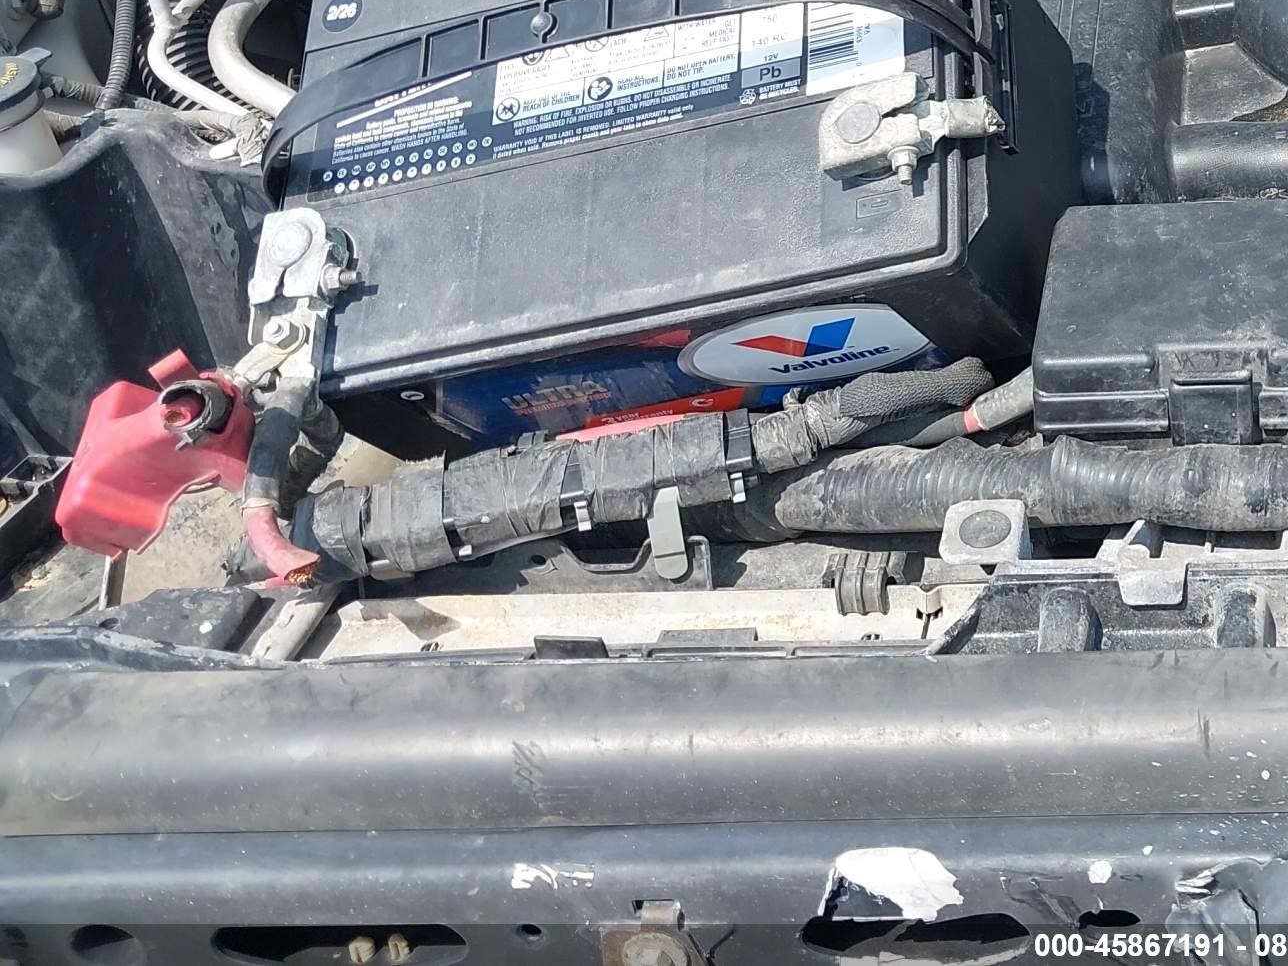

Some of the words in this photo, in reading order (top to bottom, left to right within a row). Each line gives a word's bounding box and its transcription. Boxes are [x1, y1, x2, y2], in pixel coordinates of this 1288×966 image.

[327, 2, 357, 21] 2/26
[763, 52, 778, 62] 12V
[759, 64, 781, 81] Pb
[522, 103, 540, 111] REACH
[551, 95, 579, 104] CHILDREN
[575, 103, 603, 113] EXPLOSION
[654, 84, 690, 95] DISASSEMBLE
[525, 119, 564, 132] RECOMMENDED
[577, 111, 602, 120] INVERTED
[616, 104, 637, 112] FOLLOW
[639, 98, 660, 107] PROPER
[661, 92, 688, 102] CHARGING
[493, 141, 523, 151] WARRANTY
[582, 122, 610, 132] REMOVED.
[612, 117, 634, 125] LIMITED
[635, 110, 666, 120] WARRANTY
[682, 104, 693, 112] only
[406, 139, 423, 147] HANDS
[769, 345, 889, 374] Valvoline
[501, 380, 608, 410] ULTRA
